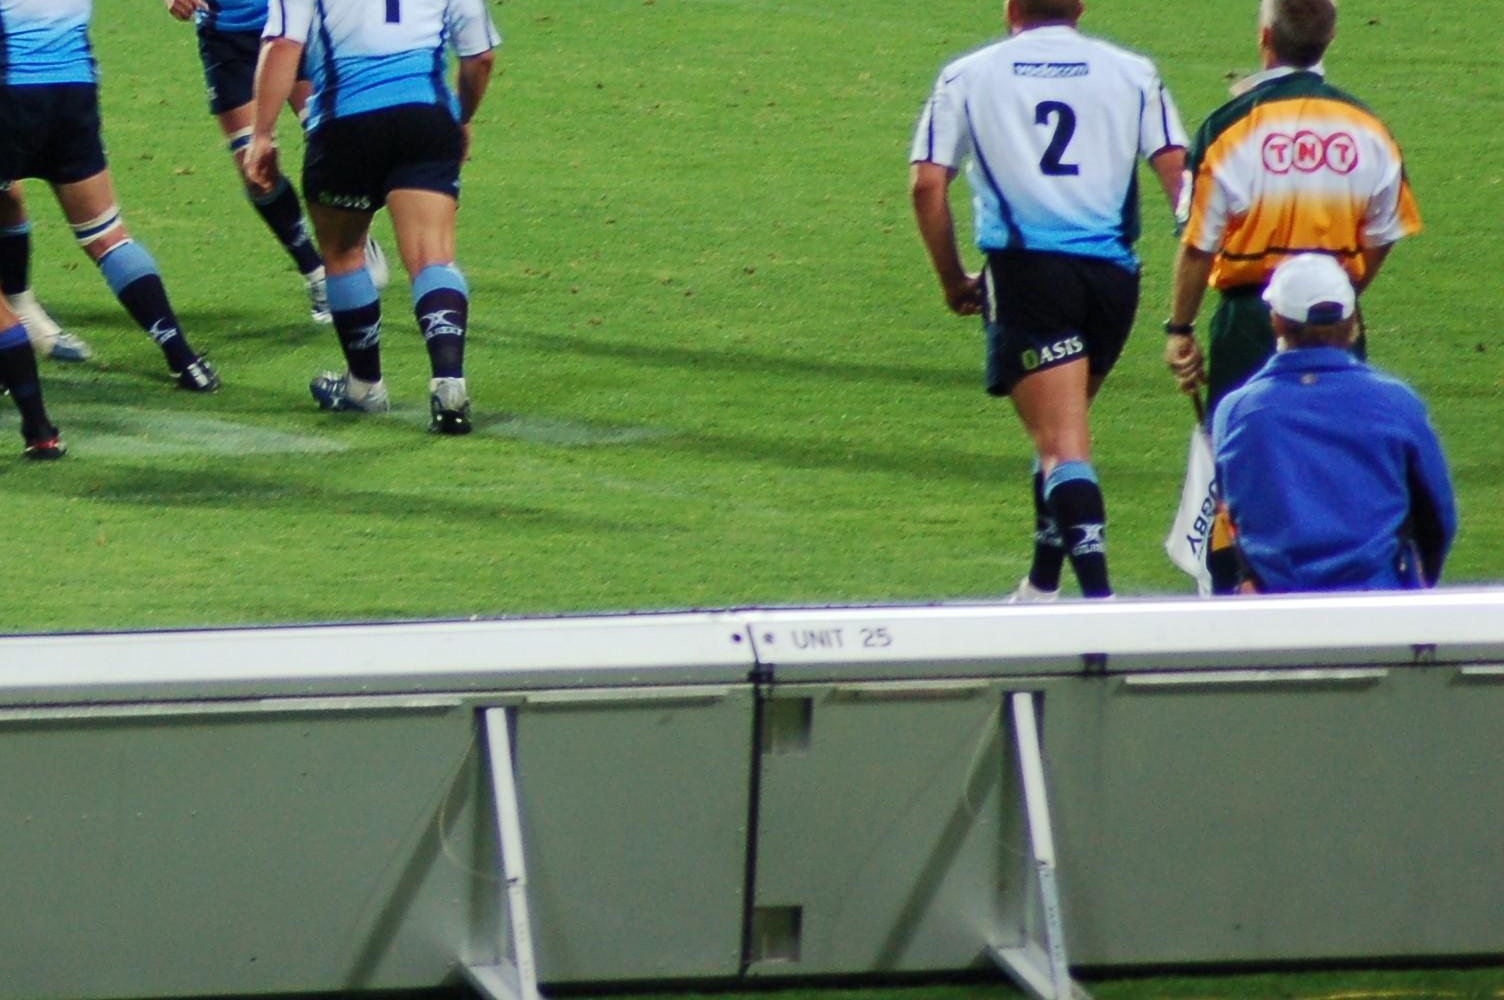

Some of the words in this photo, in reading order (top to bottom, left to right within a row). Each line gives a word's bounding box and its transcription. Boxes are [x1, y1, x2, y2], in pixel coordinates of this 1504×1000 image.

[1034, 100, 1079, 176] 2
[1267, 139, 1353, 167] TNT
[1022, 336, 1084, 370] OASIS
[791, 628, 844, 649] UNIT
[859, 627, 893, 648] 25
